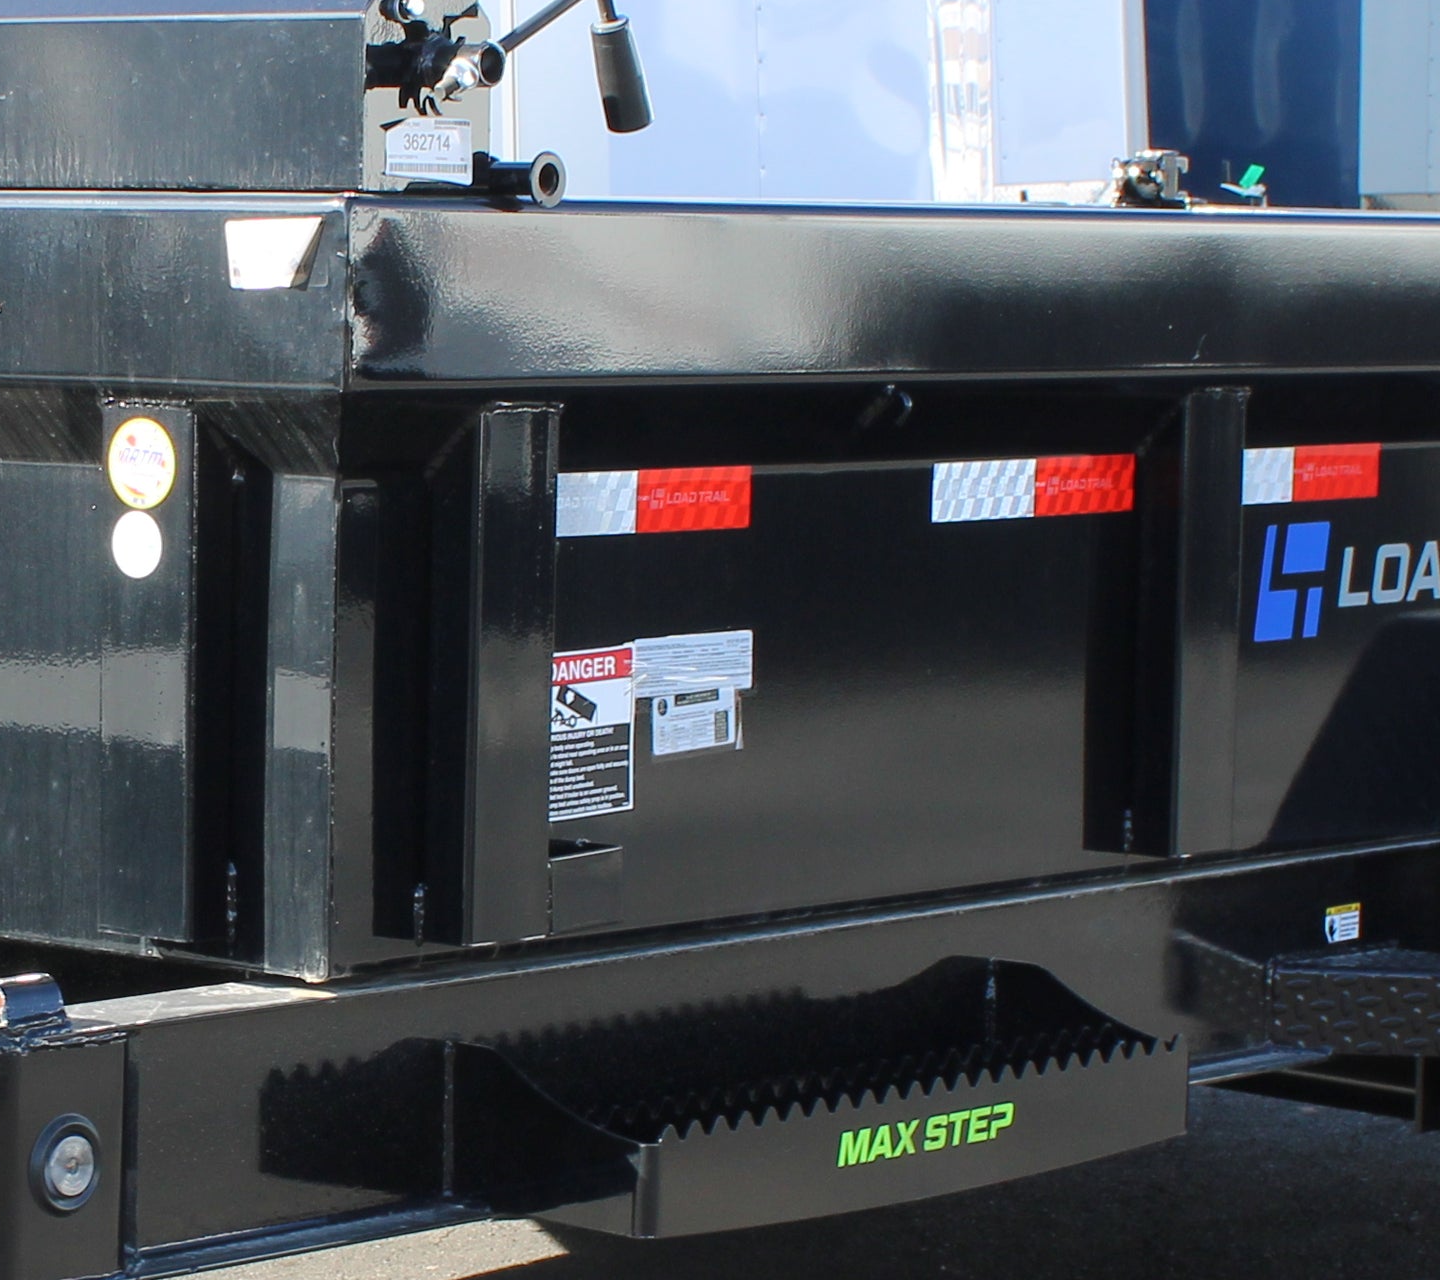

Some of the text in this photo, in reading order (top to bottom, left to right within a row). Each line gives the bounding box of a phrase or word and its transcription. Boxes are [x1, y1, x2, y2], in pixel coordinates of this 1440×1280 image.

[403, 132, 451, 152] 362714
[1059, 477, 1086, 491] LOAD
[666, 489, 731, 505] LOAD TRAIL
[837, 1102, 1015, 1168] MAX STEP
